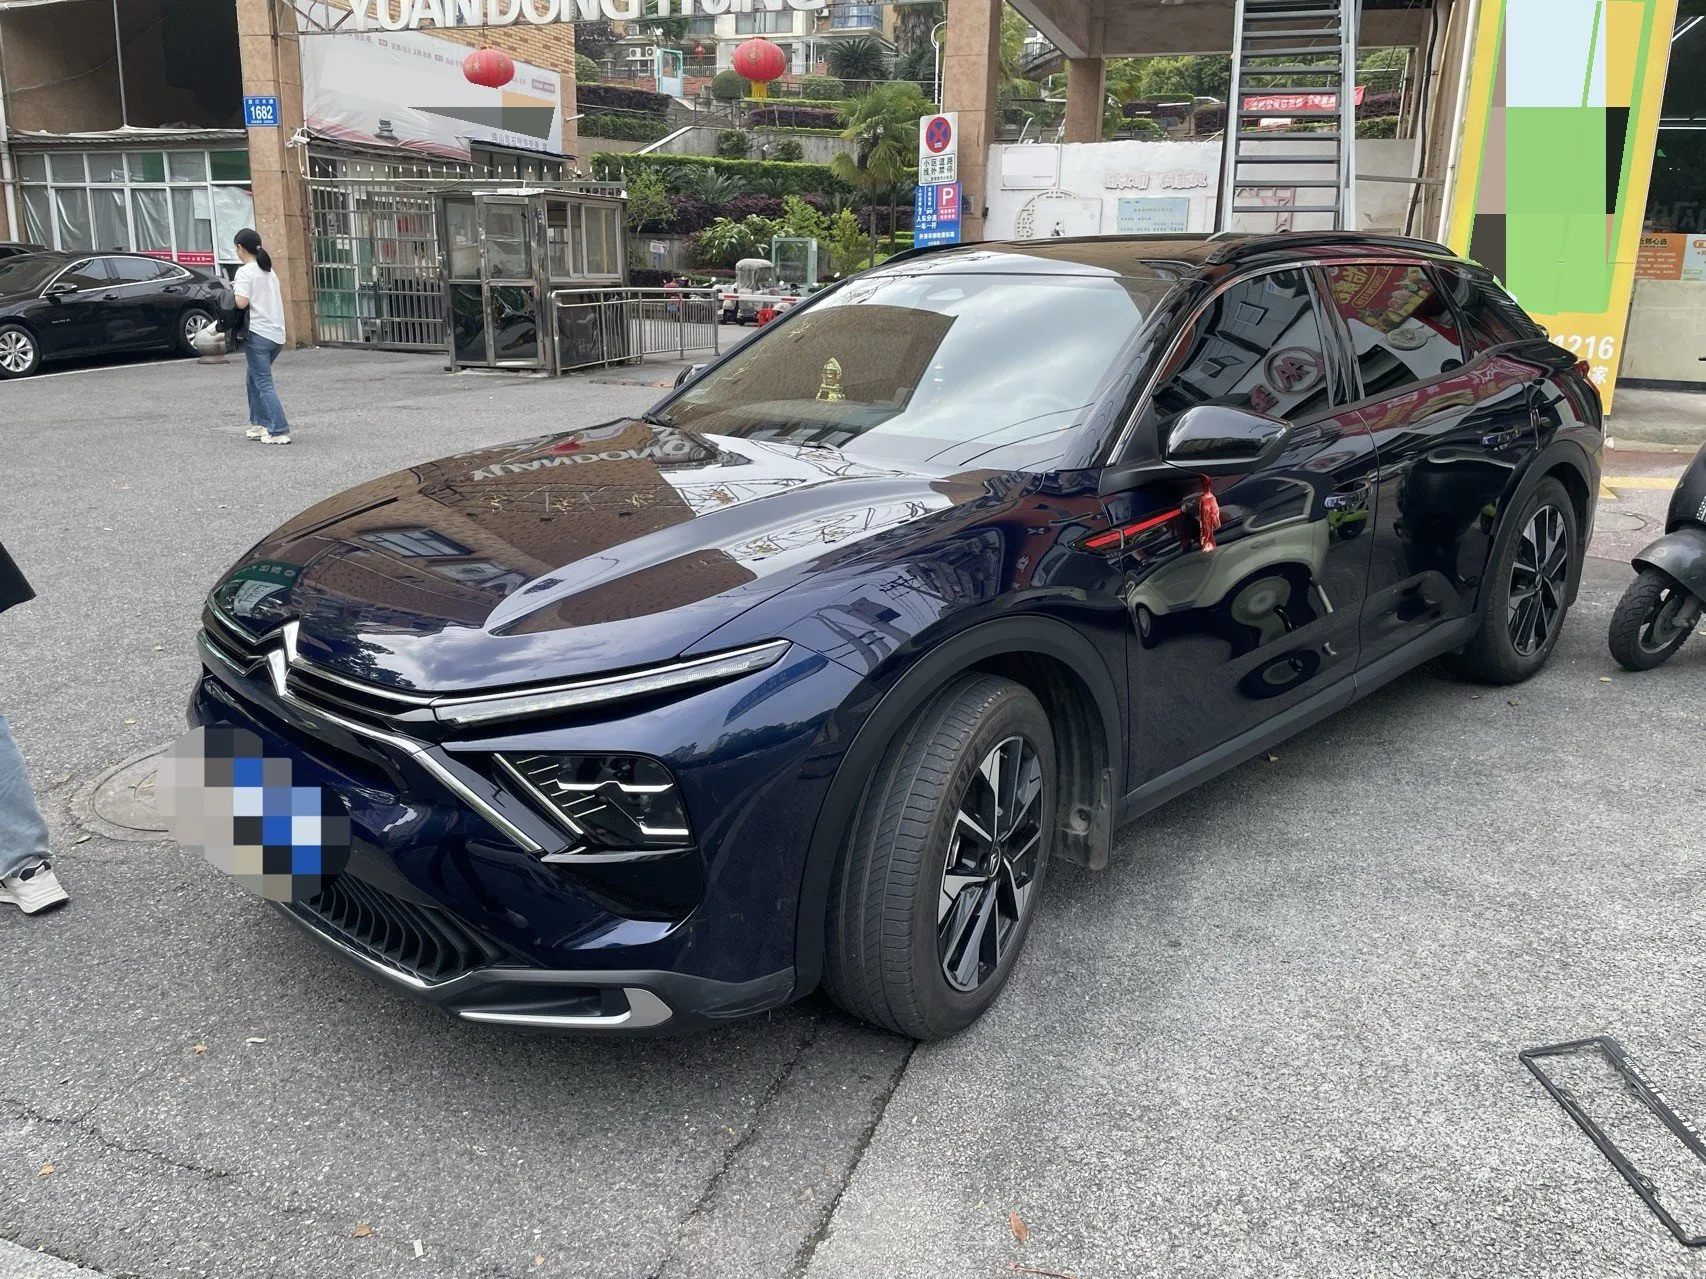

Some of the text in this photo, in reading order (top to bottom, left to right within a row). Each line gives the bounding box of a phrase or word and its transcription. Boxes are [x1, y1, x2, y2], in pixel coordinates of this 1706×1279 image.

[250, 105, 274, 120] 1682
[923, 156, 953, 168] 小区道路
[923, 165, 953, 176] 线外禁停
[942, 187, 954, 206] P
